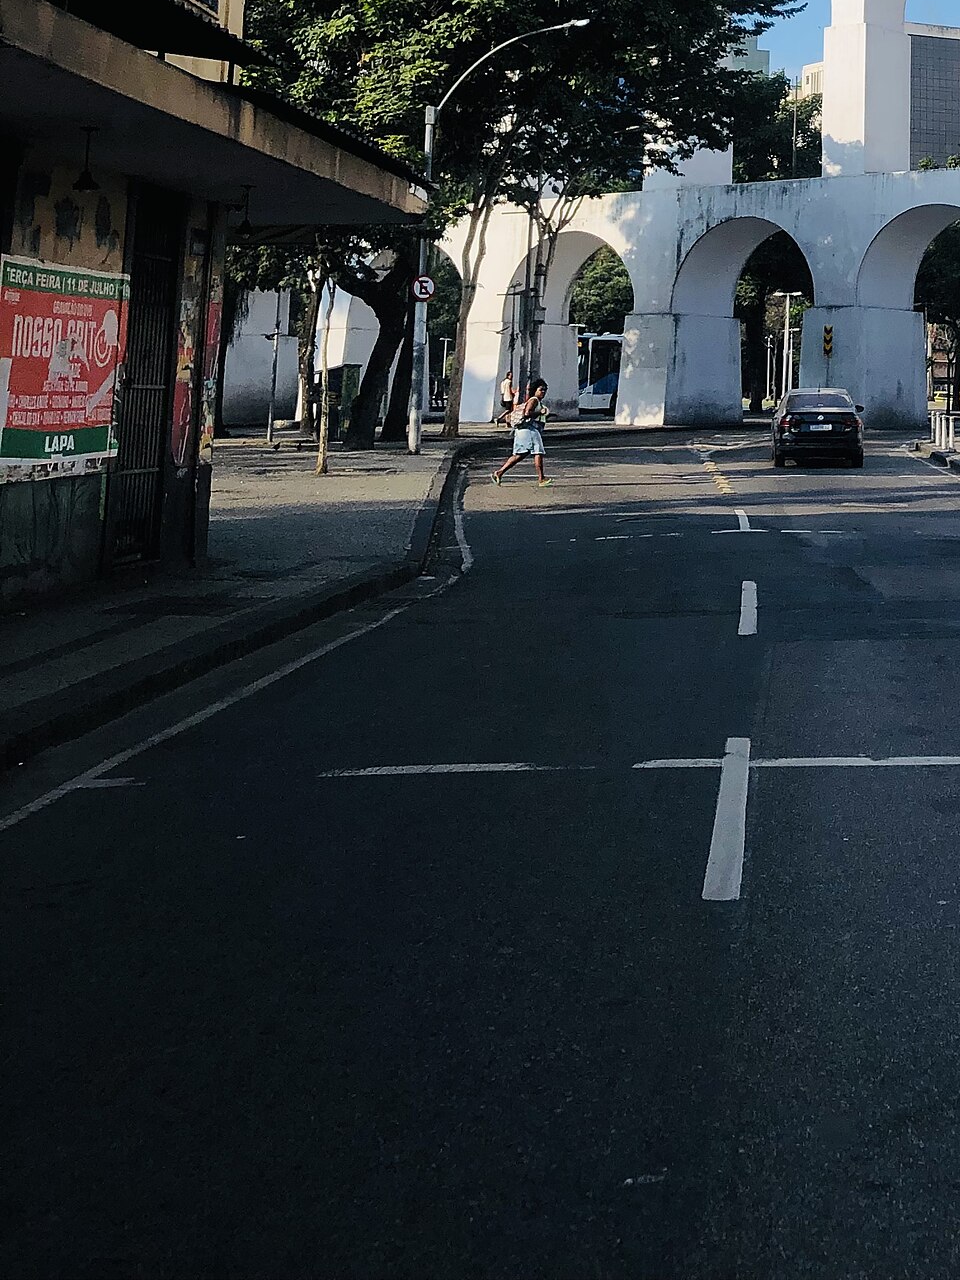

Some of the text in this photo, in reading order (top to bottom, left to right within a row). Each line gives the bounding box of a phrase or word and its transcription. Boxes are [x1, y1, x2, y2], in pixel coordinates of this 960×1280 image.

[35, 272, 60, 290] FEIRA
[77, 280, 89, 293] DE
[90, 281, 114, 296] JULHO
[44, 435, 75, 453] LAPA
